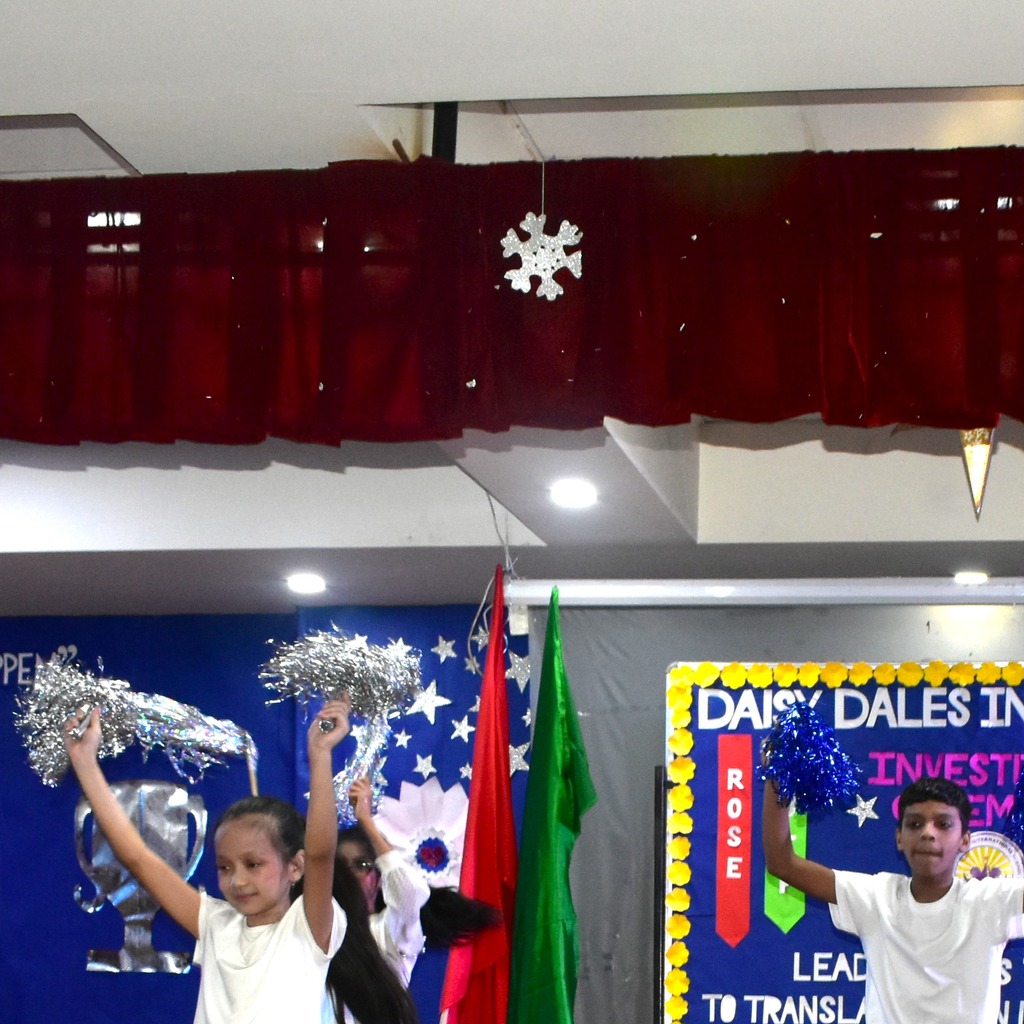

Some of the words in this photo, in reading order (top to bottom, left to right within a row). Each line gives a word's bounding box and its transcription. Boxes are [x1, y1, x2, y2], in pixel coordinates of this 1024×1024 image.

[834, 687, 971, 730] DALES
[725, 768, 744, 879] ROSE
[793, 952, 867, 982] LEAD
[702, 994, 737, 1023] TO
